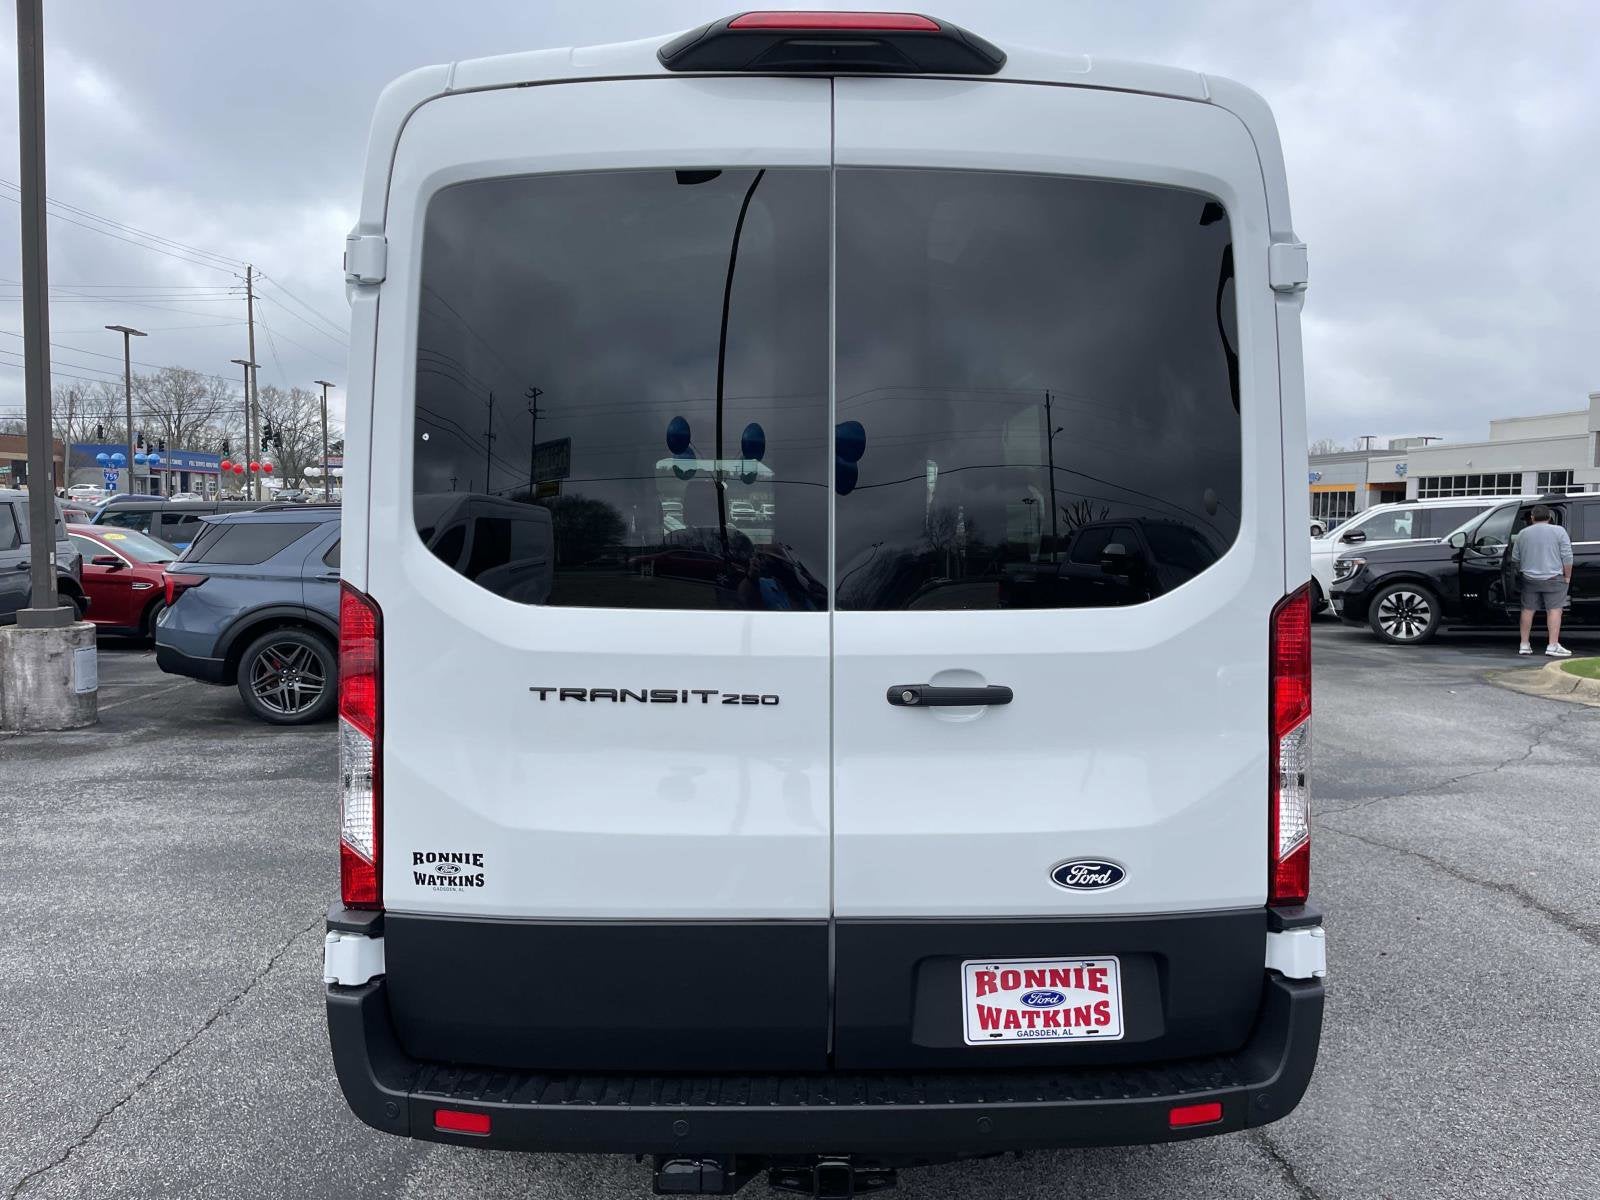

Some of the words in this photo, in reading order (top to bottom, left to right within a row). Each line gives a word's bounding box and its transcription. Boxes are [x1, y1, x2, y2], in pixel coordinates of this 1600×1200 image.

[529, 686, 719, 704] TRANSIT
[721, 693, 780, 706] 250
[412, 851, 484, 868] RONNIE
[413, 871, 485, 888] WATKINS
[1064, 863, 1114, 887] Ford
[975, 967, 1109, 998] RONNIE
[1026, 991, 1061, 1006] Ford
[976, 1000, 1111, 1030] WATKINS
[1016, 1029, 1060, 1038] GADSDEN,
[1062, 1028, 1074, 1037] AL
